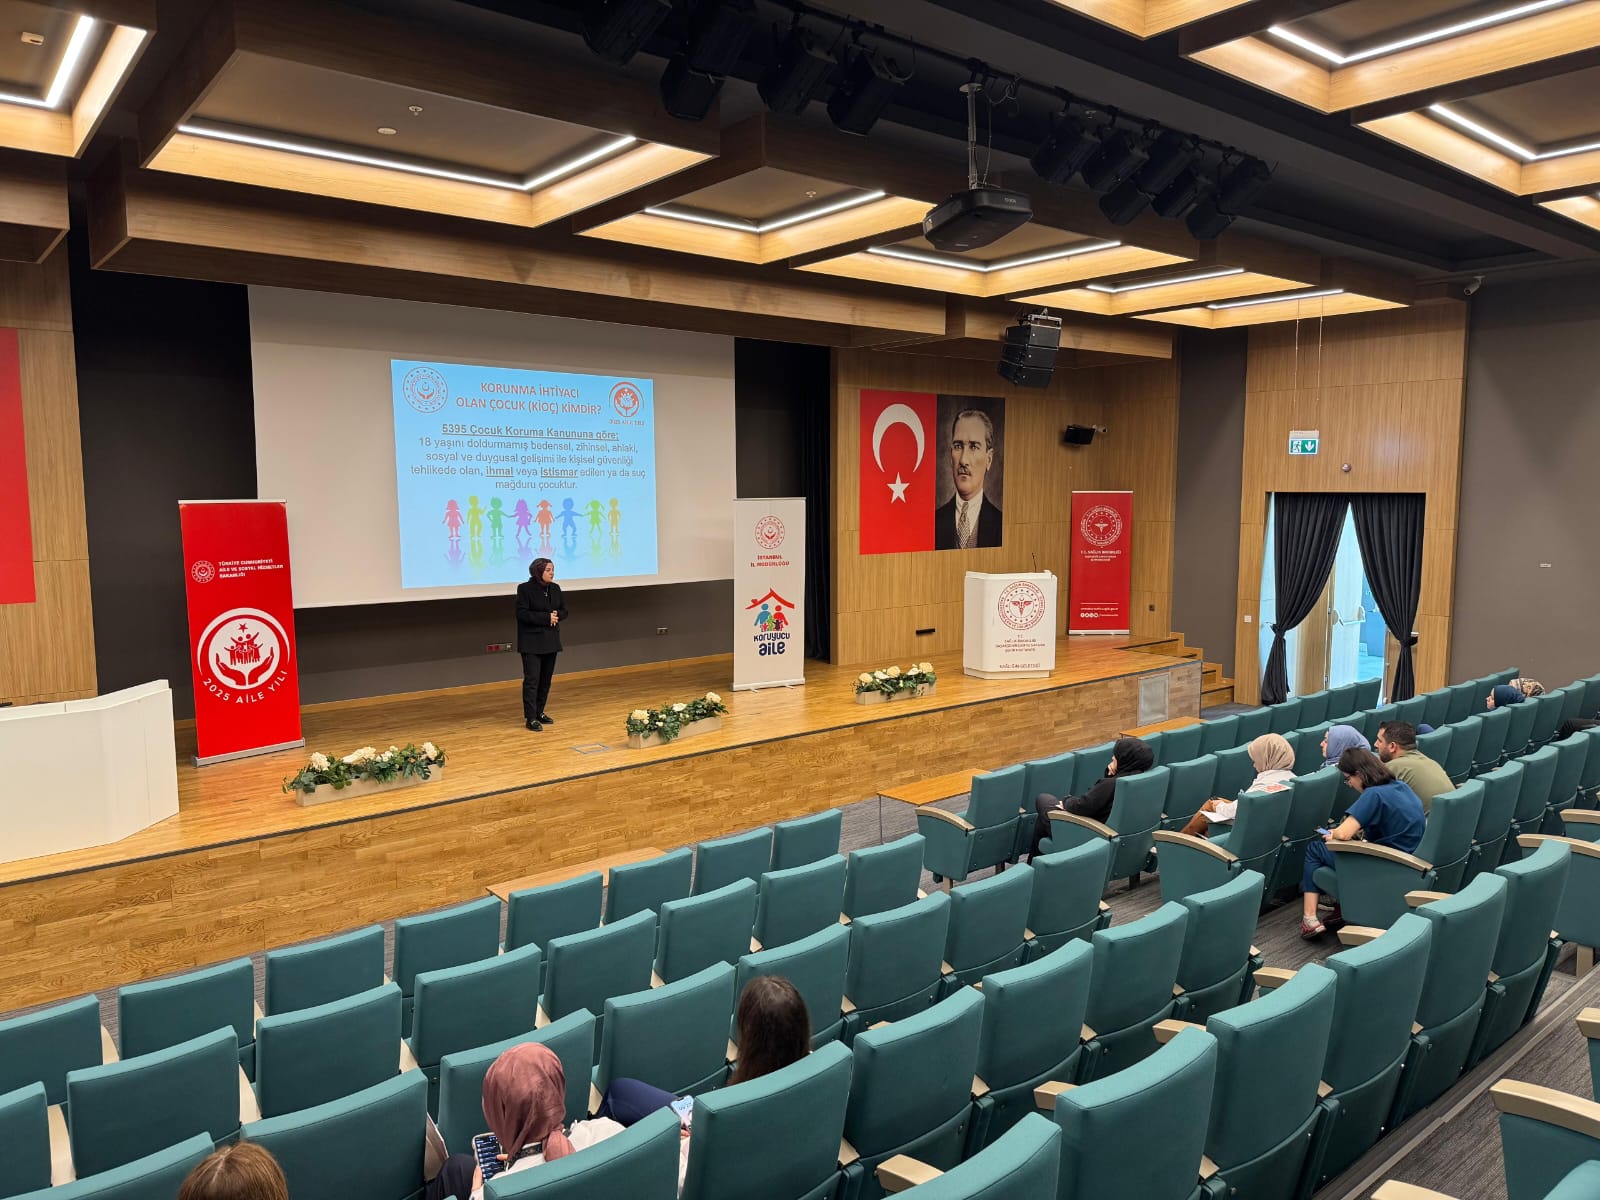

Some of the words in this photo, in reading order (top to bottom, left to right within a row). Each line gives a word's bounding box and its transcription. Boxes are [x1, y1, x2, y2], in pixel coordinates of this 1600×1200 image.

[481, 382, 536, 395] KORUNMA
[539, 384, 579, 398] İHTİYACI
[456, 397, 486, 408] OLAN
[489, 399, 525, 412] ÇOCUK
[528, 399, 559, 415] (KİOÇ)
[561, 402, 602, 415] KİMDİR?
[442, 424, 467, 433] 5395
[505, 426, 544, 437] Koruma
[547, 428, 593, 438] Kanununa
[419, 437, 432, 447] 18
[434, 438, 464, 449] yaşını
[467, 438, 529, 451] doldurmamış
[531, 441, 574, 452] bedensel,
[426, 452, 458, 463] sosyal
[460, 453, 473, 461] ve
[475, 452, 518, 464] duygusal
[521, 454, 555, 465] gelişimi
[556, 454, 567, 463] ile
[569, 455, 595, 466] kişisel
[411, 465, 457, 475] tehlikede
[459, 465, 483, 476] olan,
[486, 465, 514, 477] ihmal
[516, 468, 538, 478] veya
[580, 467, 605, 477] edilen
[607, 469, 617, 478] ya
[619, 468, 630, 477] da
[631, 470, 646, 480] suç
[495, 480, 536, 491] mağduru
[538, 480, 578, 491] çocuktur.
[758, 641, 786, 656] aile
[203, 678, 230, 701] 2025
[267, 670, 288, 692] YILI
